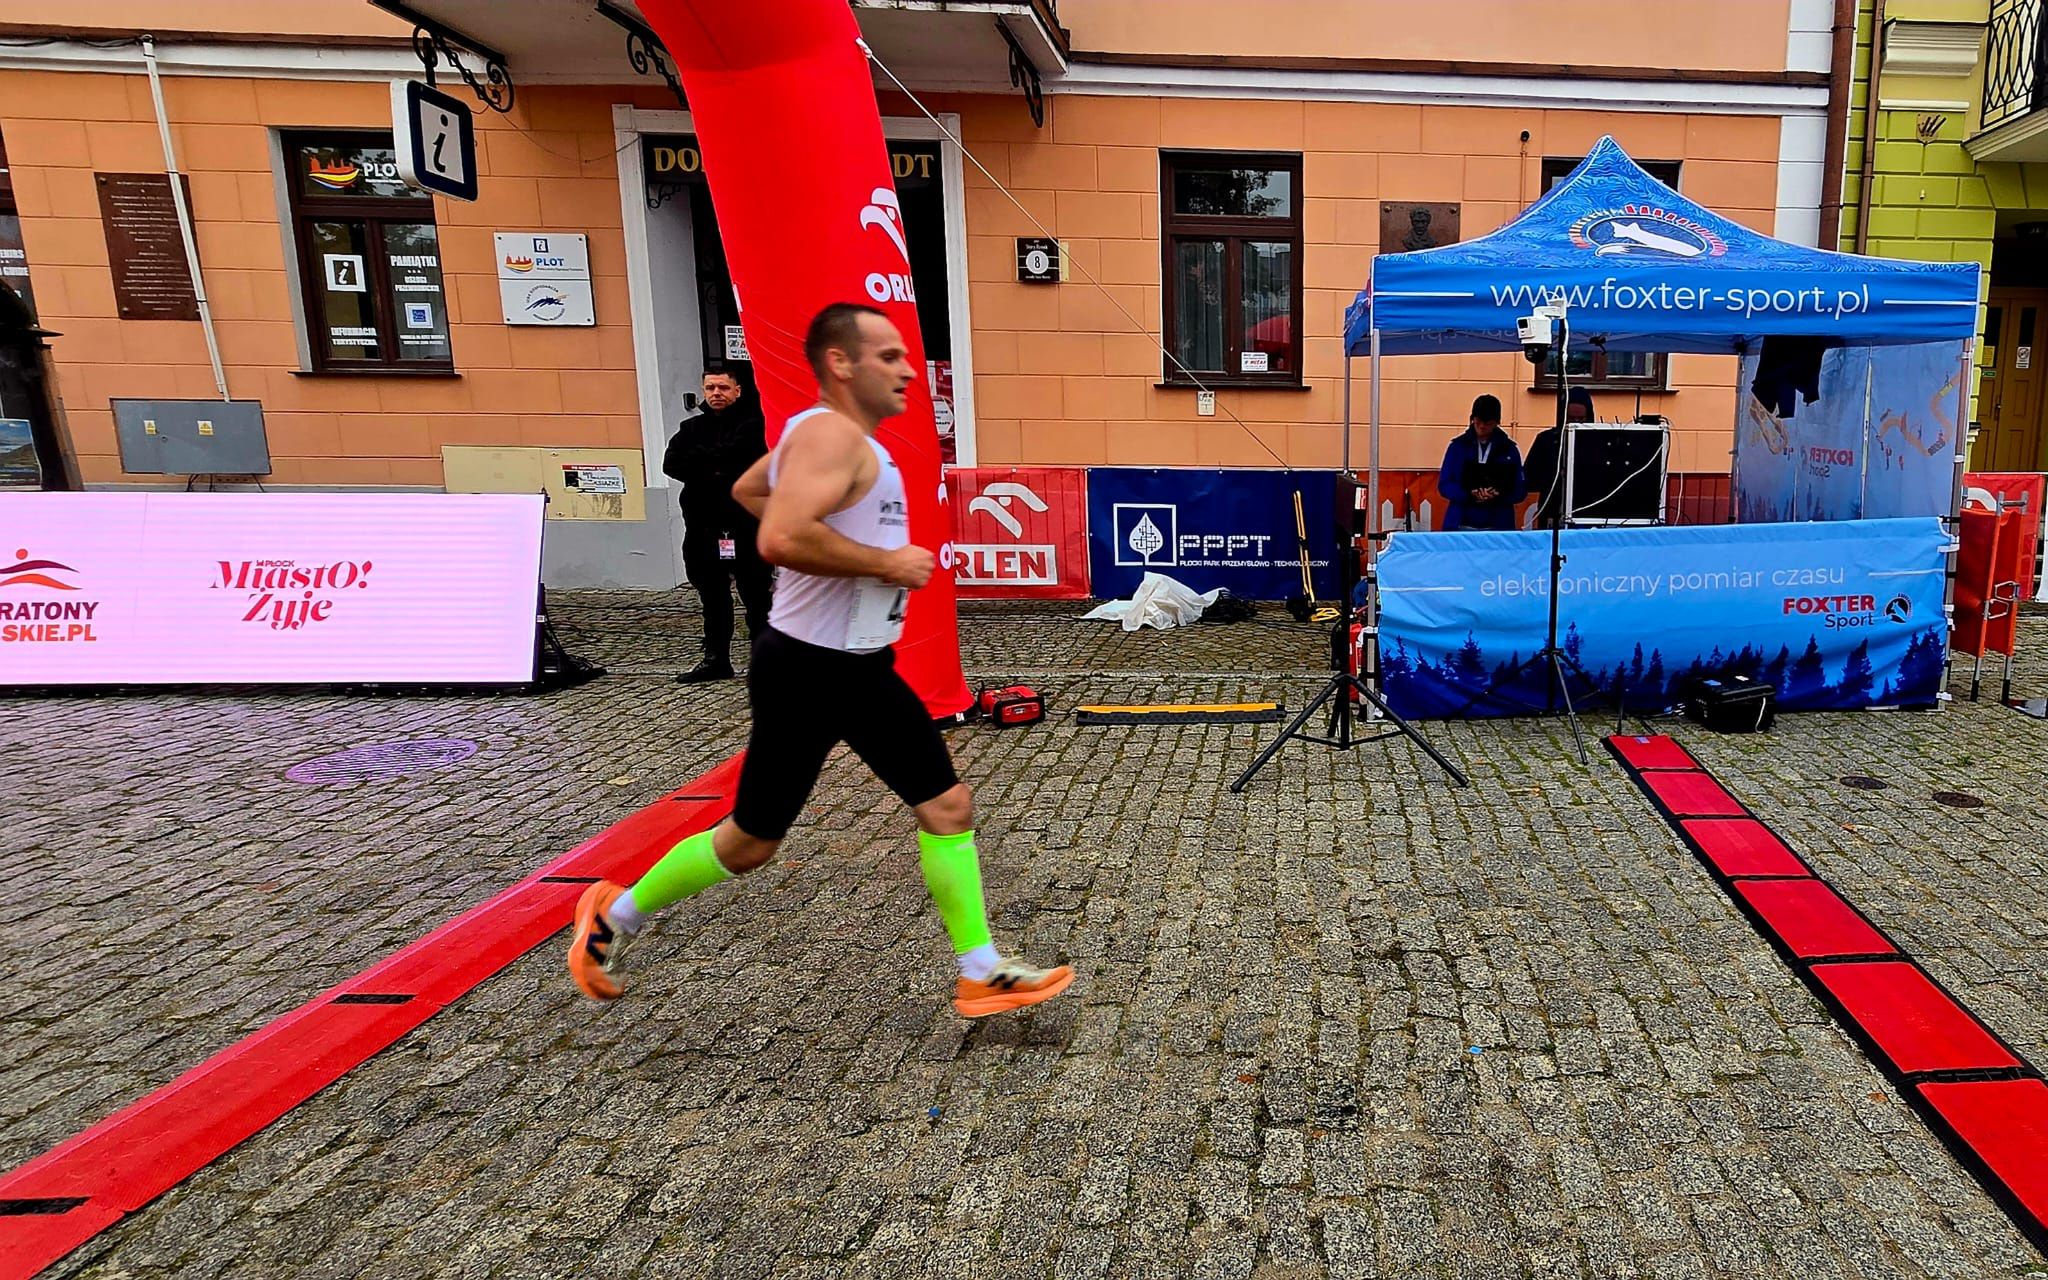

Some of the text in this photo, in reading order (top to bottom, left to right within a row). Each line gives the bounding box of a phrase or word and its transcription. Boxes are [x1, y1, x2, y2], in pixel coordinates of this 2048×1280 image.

[362, 162, 399, 177] PLO
[653, 147, 705, 172] DO
[390, 255, 437, 268] PAMIĄTKI
[536, 257, 564, 267] PLOT
[1034, 255, 1041, 269] 8
[864, 272, 916, 302] ORL
[1489, 277, 1868, 321] www.foxter-sport.pl
[1179, 534, 1271, 557] PPPT
[1480, 566, 1844, 598] elektoniczny pomiar czasu
[1782, 594, 1875, 616] FOXTER
[1823, 612, 1875, 632] Sport
[2, 624, 97, 642] SKIE.PL
